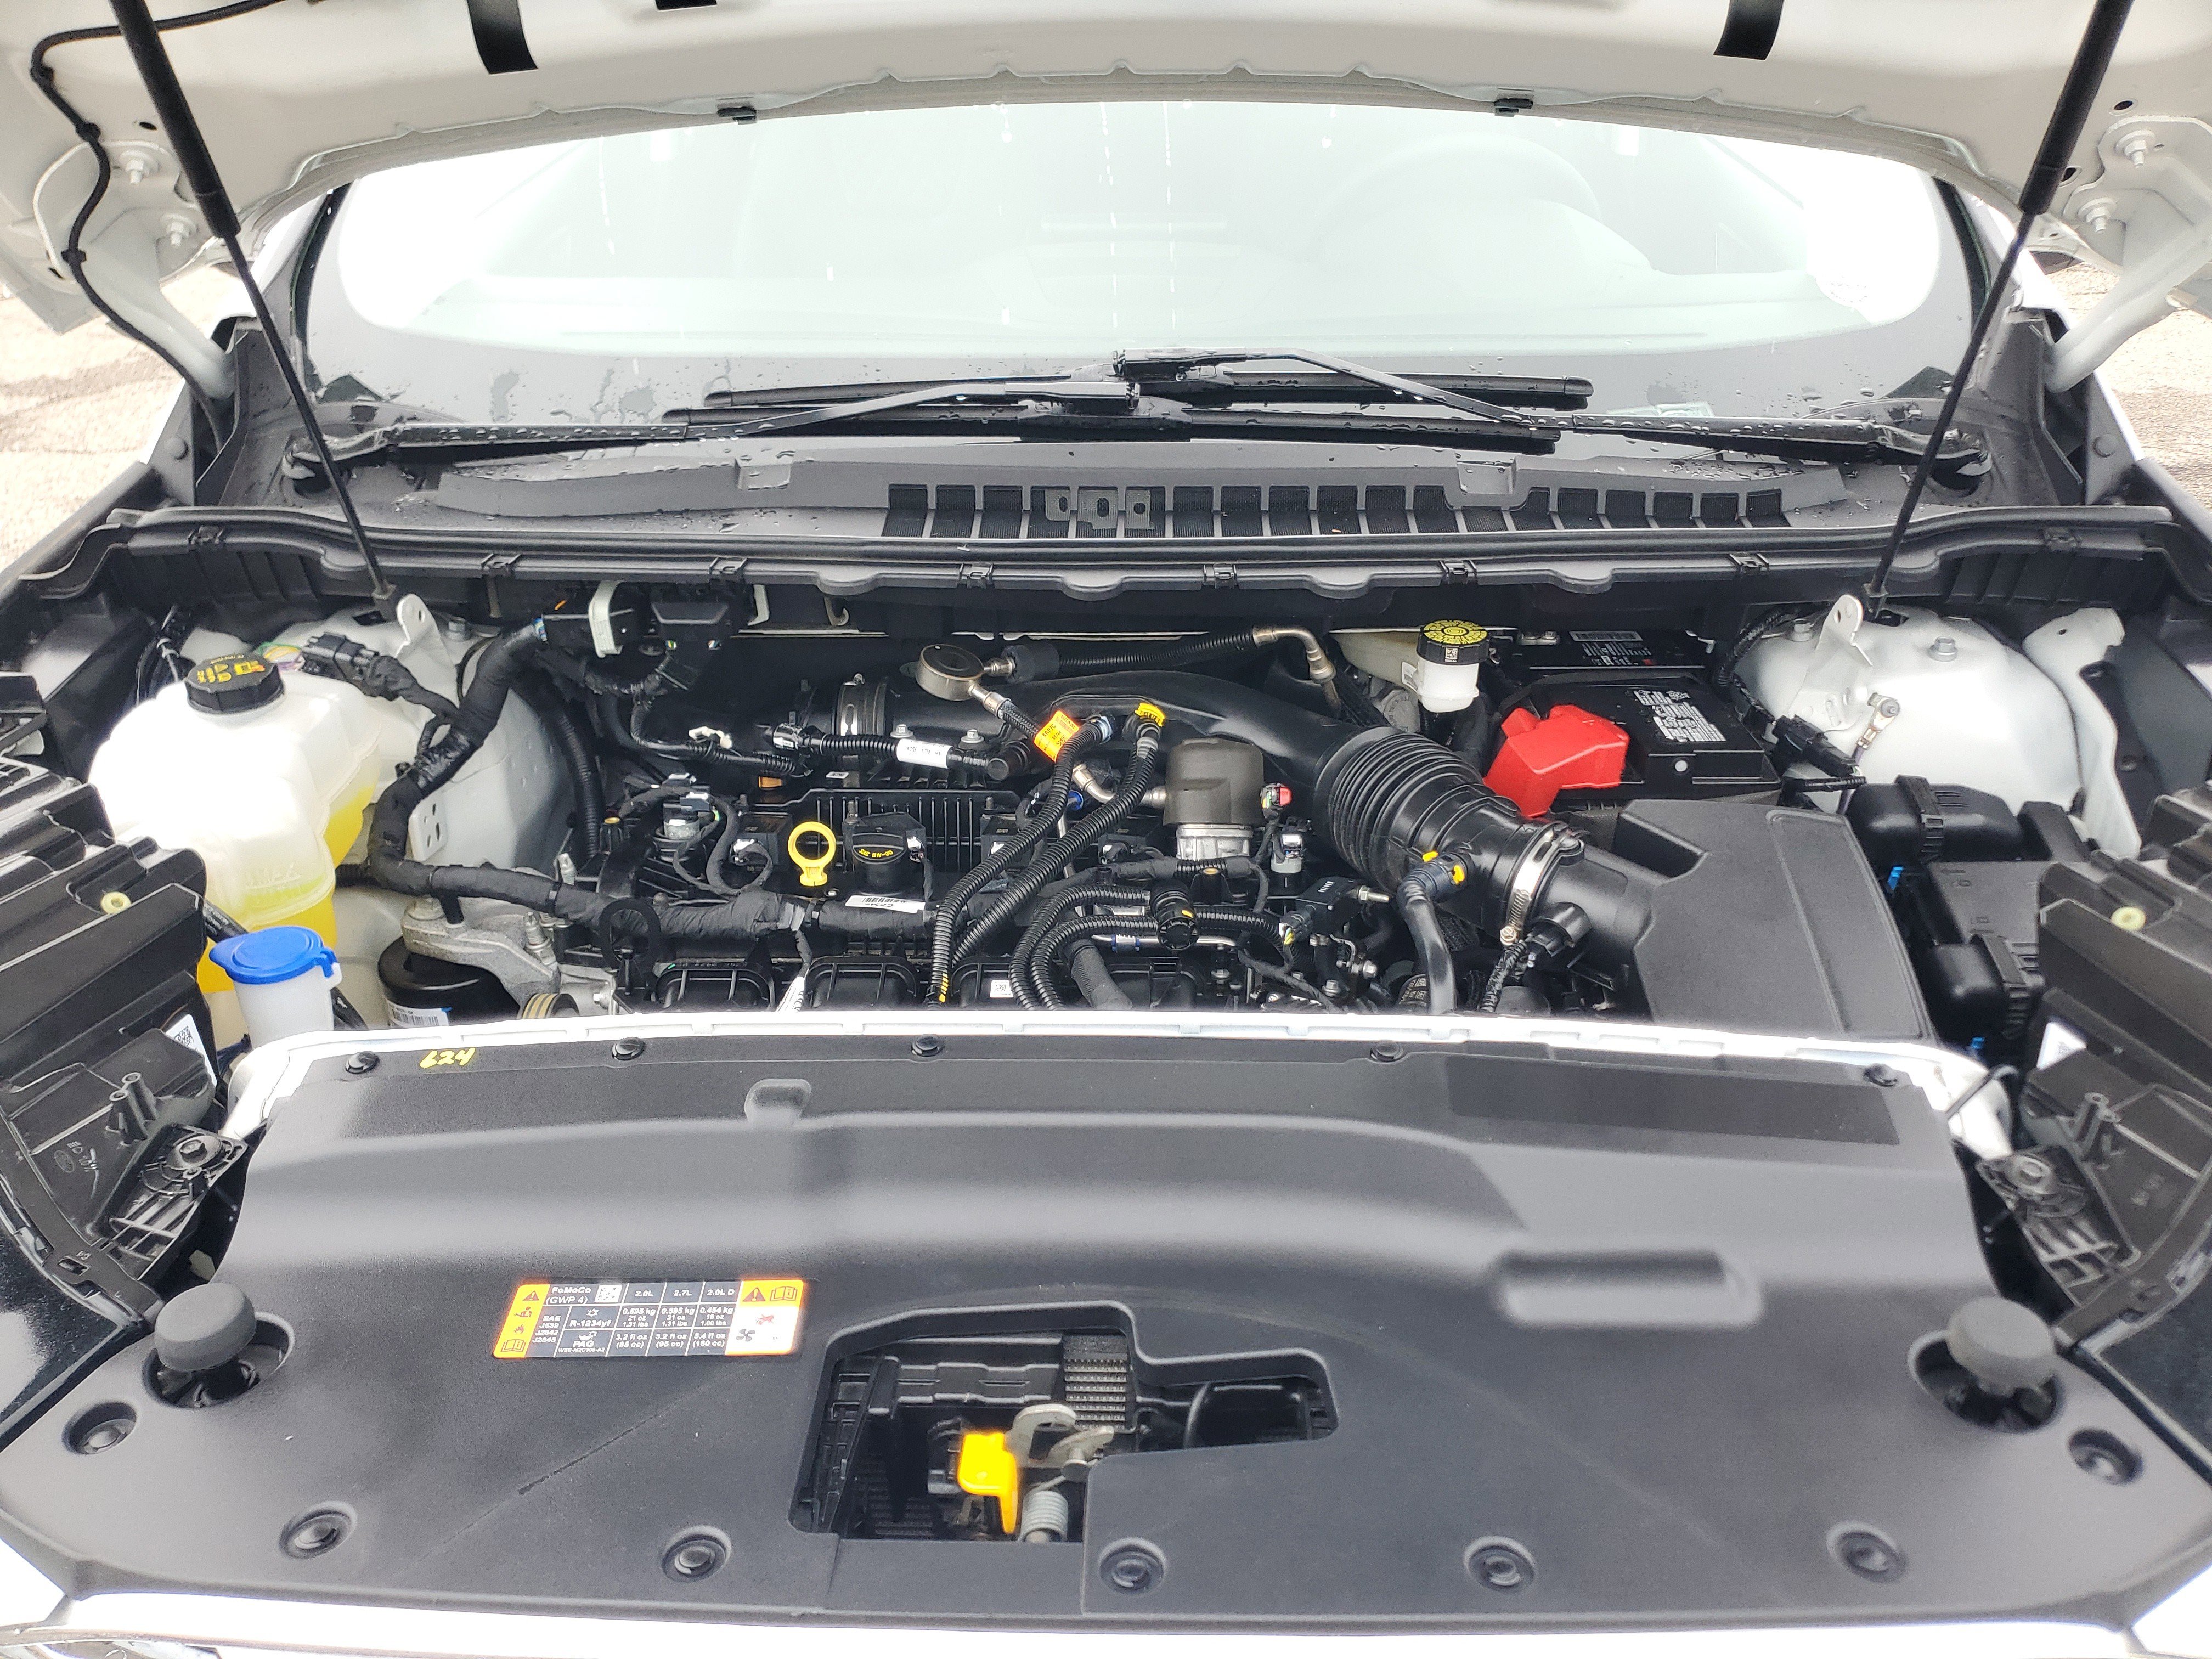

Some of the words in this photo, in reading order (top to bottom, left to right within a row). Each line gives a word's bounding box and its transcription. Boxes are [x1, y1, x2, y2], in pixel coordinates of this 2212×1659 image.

[545, 1296, 576, 1305] (GWP
[578, 1296, 588, 1305] 4)
[723, 1307, 733, 1315] kg
[569, 1319, 612, 1328] R-1234yf
